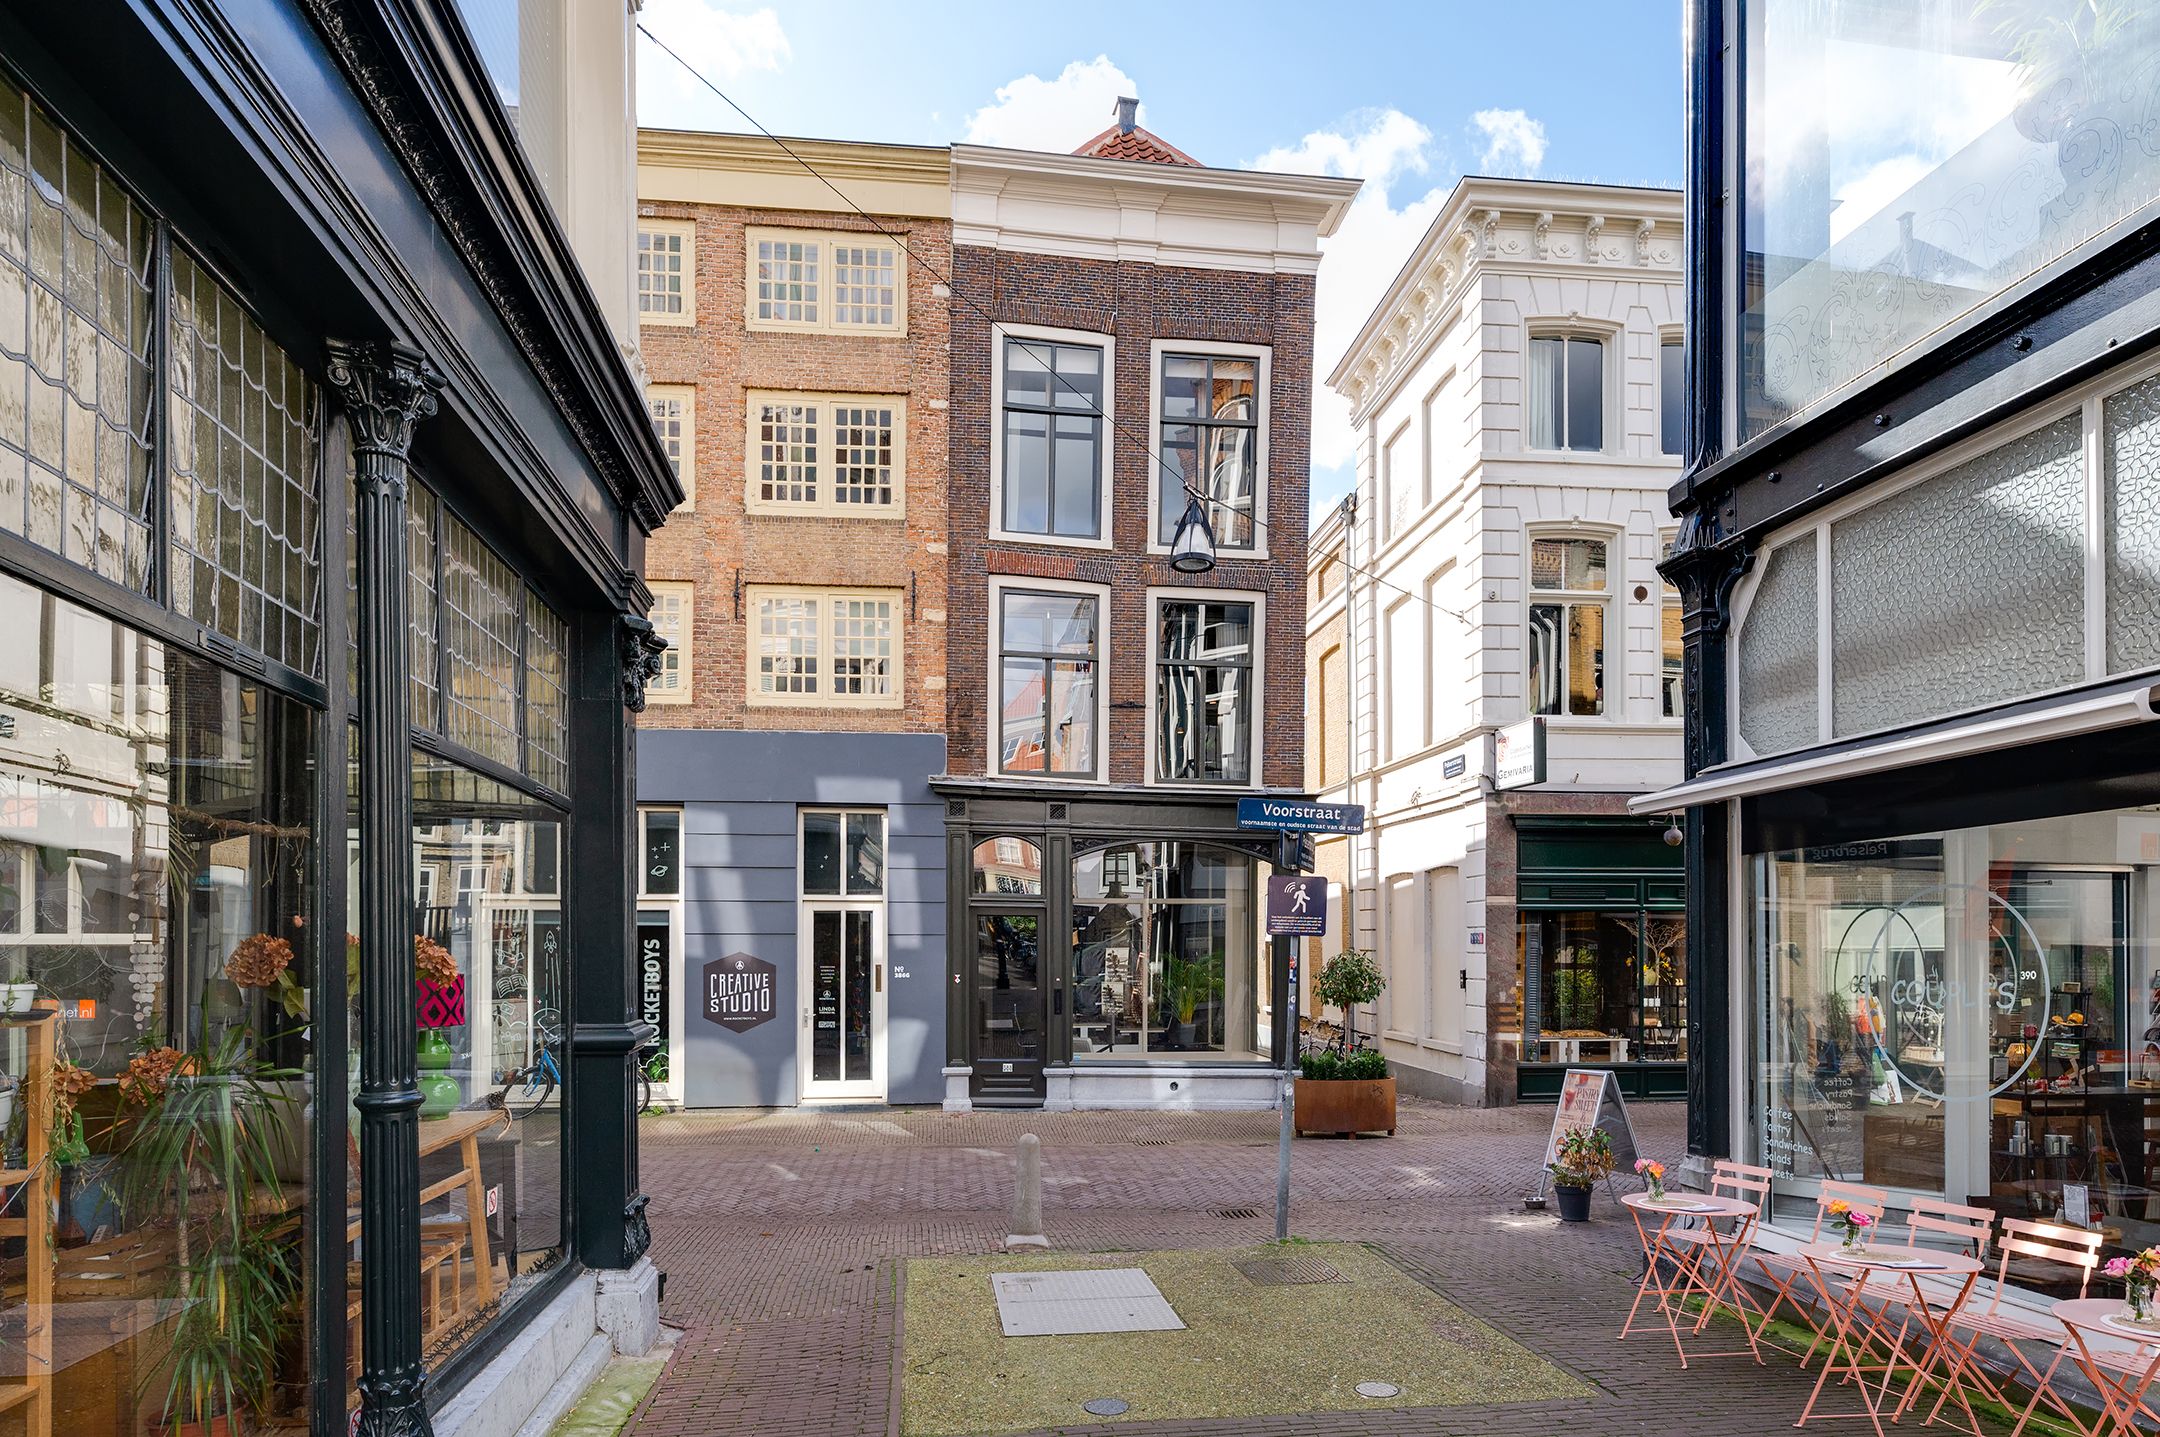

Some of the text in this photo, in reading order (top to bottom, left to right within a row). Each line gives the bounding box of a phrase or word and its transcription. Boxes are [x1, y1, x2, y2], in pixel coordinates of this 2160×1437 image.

[1262, 803, 1341, 820] Voorstraat
[2020, 970, 2037, 980] 390
[643, 939, 661, 1047] ROCKETBOYS
[710, 973, 769, 999] CREATIVE
[710, 988, 770, 1013] STUDIO
[1763, 1105, 1793, 1120] Coffee
[1762, 1120, 1791, 1138] Pastry
[1762, 1135, 1813, 1155] Sandwiches
[1762, 1150, 1792, 1166] Salads
